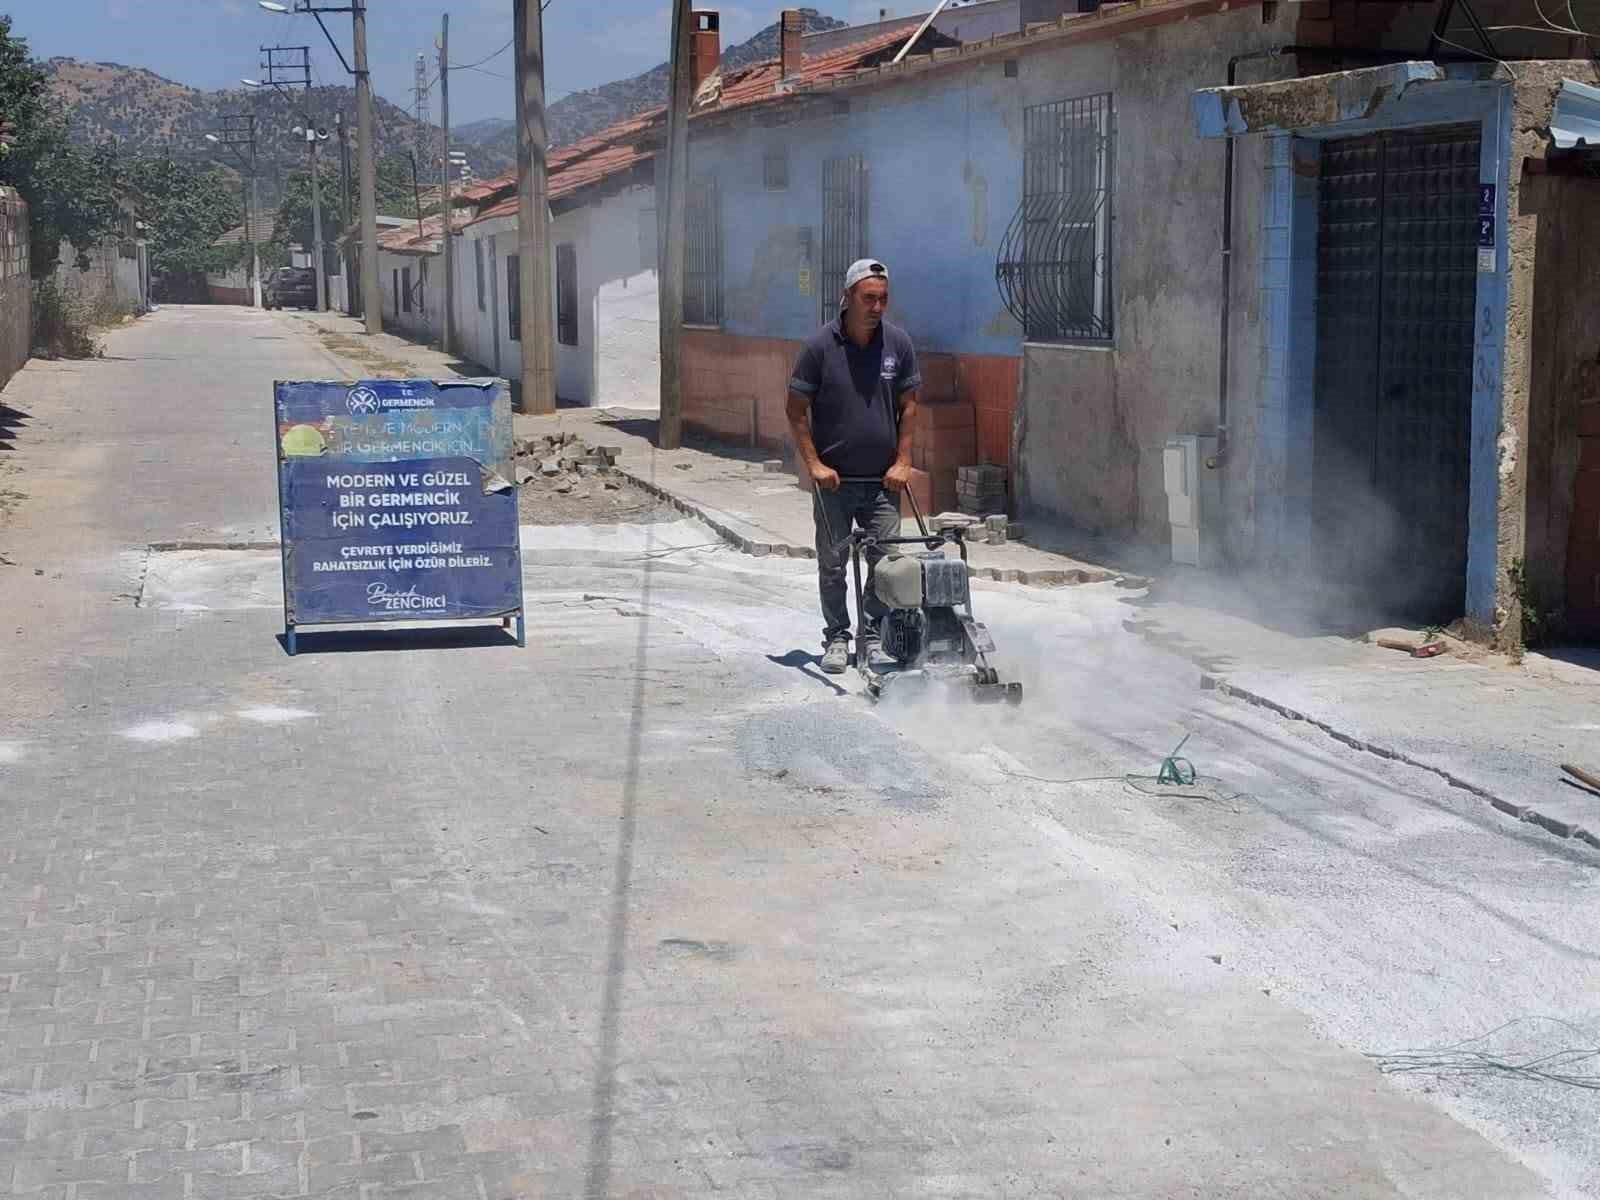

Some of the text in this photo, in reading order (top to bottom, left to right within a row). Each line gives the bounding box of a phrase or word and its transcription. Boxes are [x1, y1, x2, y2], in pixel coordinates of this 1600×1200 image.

[326, 472, 472, 488] MODERN VE GÜZEL
[339, 491, 460, 507] BİR GERMENCİK
[332, 511, 473, 530] İÇİN ÇALIŞIYORUZ.
[341, 541, 463, 559] ÇEVREYE VERDİĞİMİZ
[313, 560, 386, 571] RAHATSIZLIK
[388, 557, 413, 572] İÇİN
[415, 556, 446, 568] ÖZÜR
[385, 595, 446, 609] ZENCİRCİ
